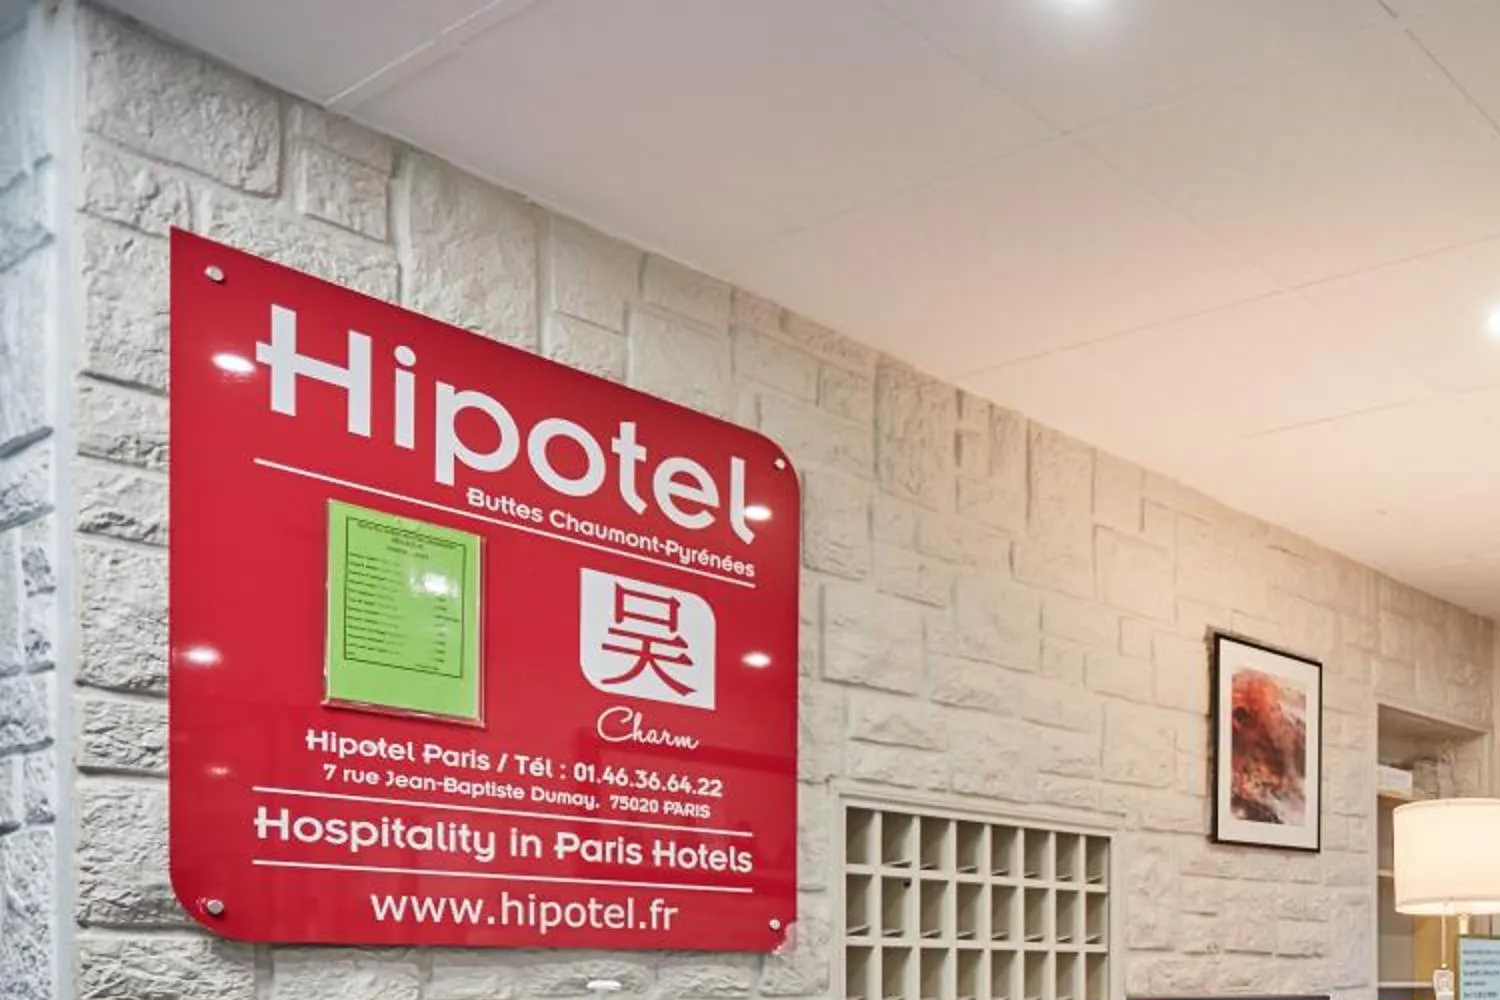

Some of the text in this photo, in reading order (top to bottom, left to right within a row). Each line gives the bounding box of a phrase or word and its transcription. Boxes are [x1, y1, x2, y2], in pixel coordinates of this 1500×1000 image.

[255, 303, 773, 545] Hipotel
[466, 487, 756, 578] Buttes Chaumont-Pyrénées
[596, 705, 700, 749] Charm
[305, 728, 416, 762] Hipotel
[422, 743, 491, 771] Paris
[513, 754, 554, 779] Tél
[573, 762, 723, 798] 01.46.36.64.22
[323, 763, 337, 781] 7
[343, 768, 380, 785] rue
[385, 770, 526, 800] Jean-Baptiste
[609, 794, 660, 814] 75020
[662, 800, 711, 820] PARIS
[253, 806, 753, 873] Hospitality in Paris Hotels
[370, 891, 679, 935] www.hipotel.fr
